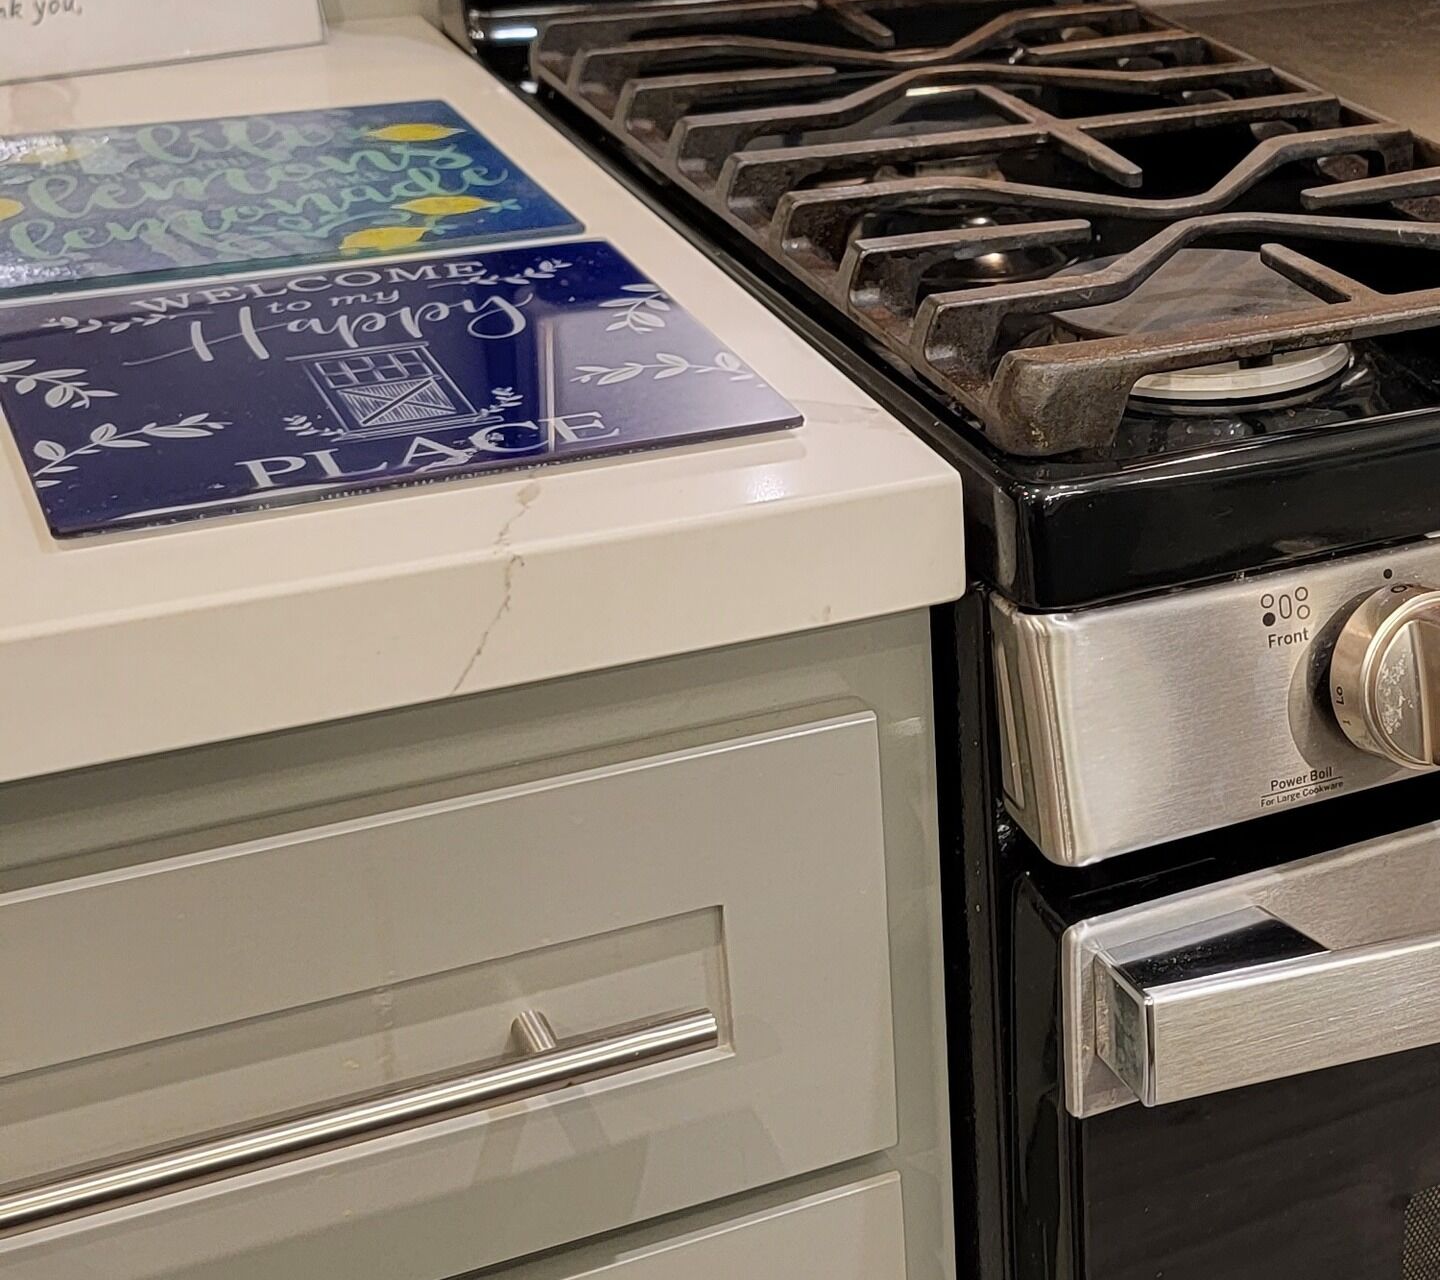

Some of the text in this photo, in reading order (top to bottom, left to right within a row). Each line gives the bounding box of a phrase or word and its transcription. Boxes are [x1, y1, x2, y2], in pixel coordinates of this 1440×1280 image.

[28, 144, 473, 218] lemons
[10, 167, 508, 260] lemonade
[130, 260, 488, 314] WELCOME
[266, 288, 401, 315] to my
[123, 292, 534, 366] Happy
[235, 410, 622, 489] PLACE
[1268, 627, 1310, 649] Front
[1260, 780, 1344, 808] For Large Cookware
[1270, 766, 1333, 792] Power Boil
